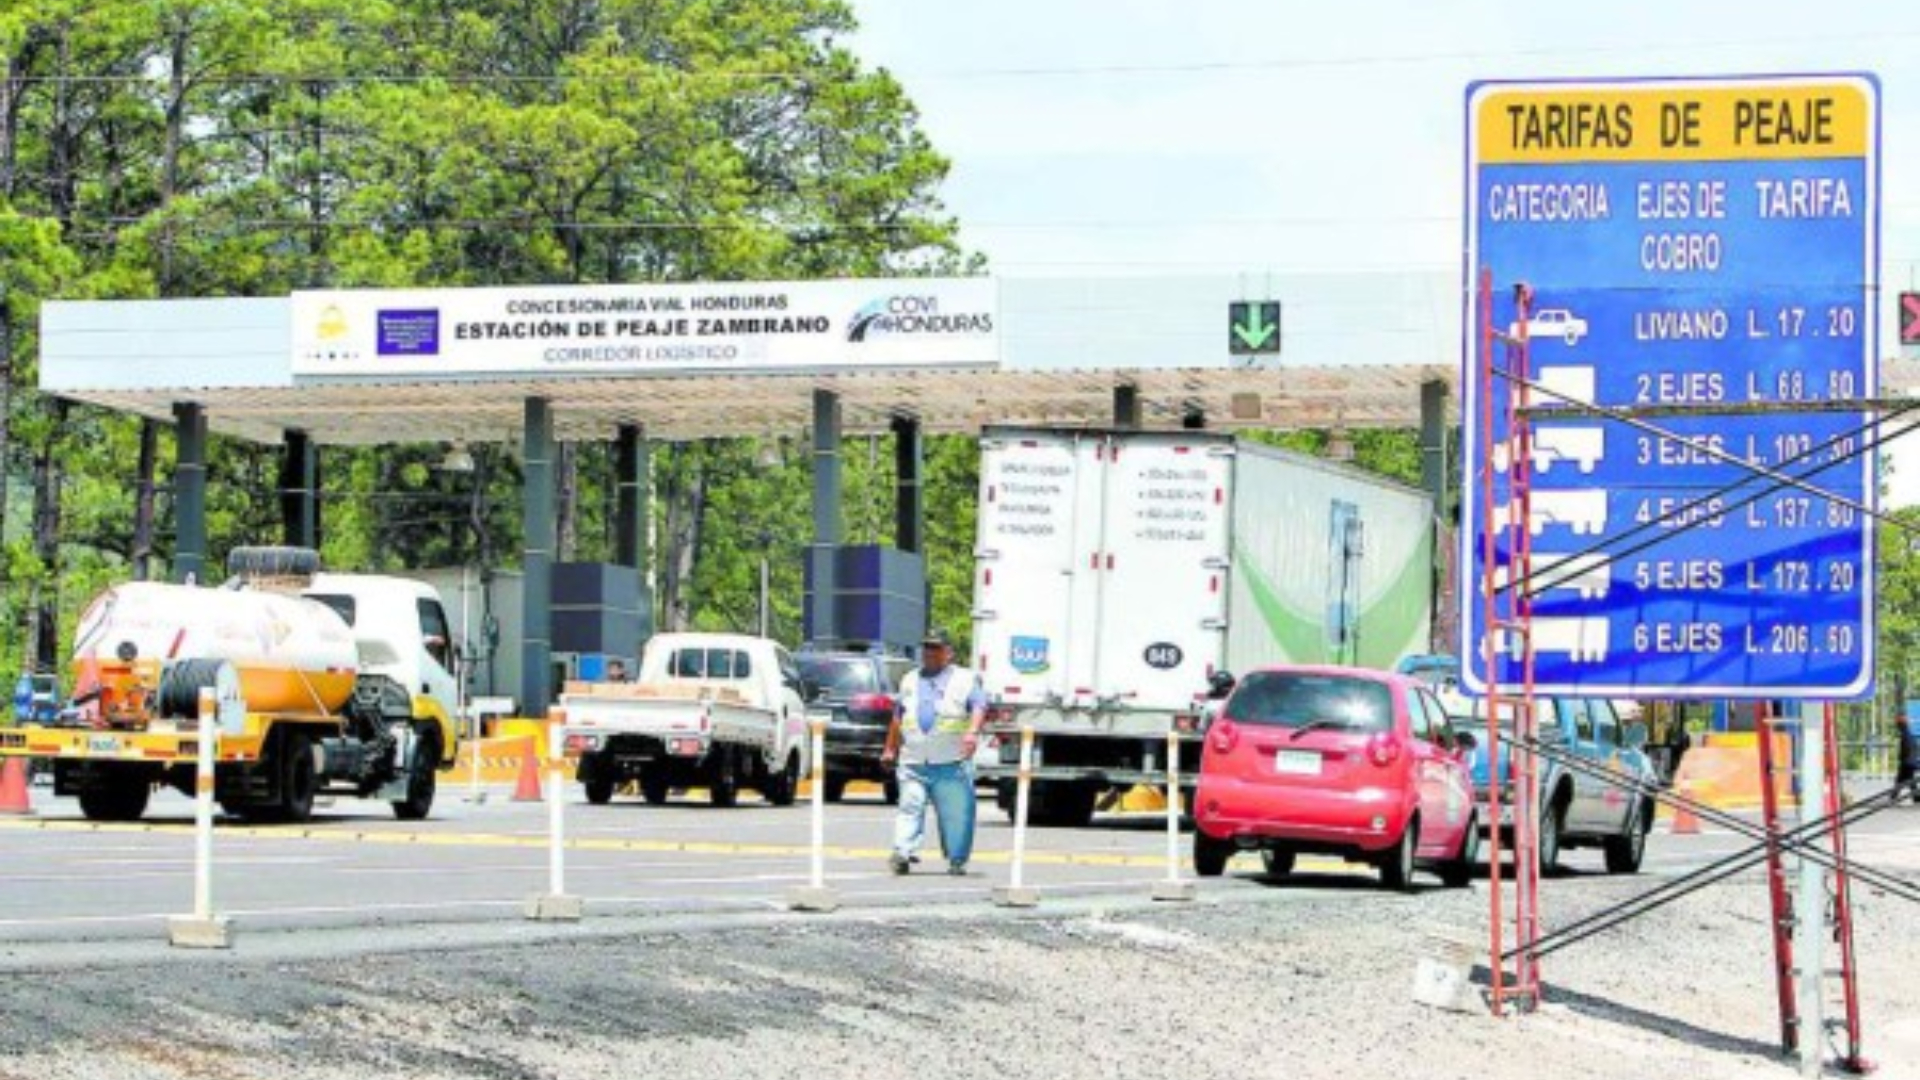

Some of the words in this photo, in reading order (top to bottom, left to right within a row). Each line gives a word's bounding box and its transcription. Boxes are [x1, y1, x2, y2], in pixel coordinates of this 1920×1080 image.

[1507, 102, 1633, 149] TARIFAS
[1660, 102, 1700, 147] DE
[1734, 98, 1833, 146] PEAJE
[1489, 184, 1608, 221] CATEGORIA
[1638, 181, 1690, 218] EJES
[1698, 181, 1726, 218] DE
[1756, 178, 1851, 218] TARIFA
[1641, 234, 1720, 271] COBRO
[506, 298, 647, 314] CONCESIONARIA
[651, 296, 685, 312] VIAL
[690, 295, 788, 311] HONDURAS
[888, 296, 938, 314] COVI
[455, 319, 568, 340] ESTACIÓN
[577, 319, 606, 338] DE
[615, 317, 688, 337] PEAJE
[697, 315, 830, 335] ZAMBRANO
[886, 313, 993, 333] HONDURAS
[1635, 311, 1728, 339] LIVIANO
[543, 345, 642, 363] CORREDOR
[1637, 375, 1652, 402] 2
[1658, 373, 1725, 401] EJES
[1638, 438, 1652, 466] 3
[1658, 438, 1725, 465] EJES
[1636, 500, 1652, 527] 4
[1659, 499, 1724, 527] EJES
[1636, 563, 1652, 590] 5
[1659, 562, 1724, 590] EJES
[1634, 625, 1650, 652] 6
[1656, 624, 1723, 652] EJES
